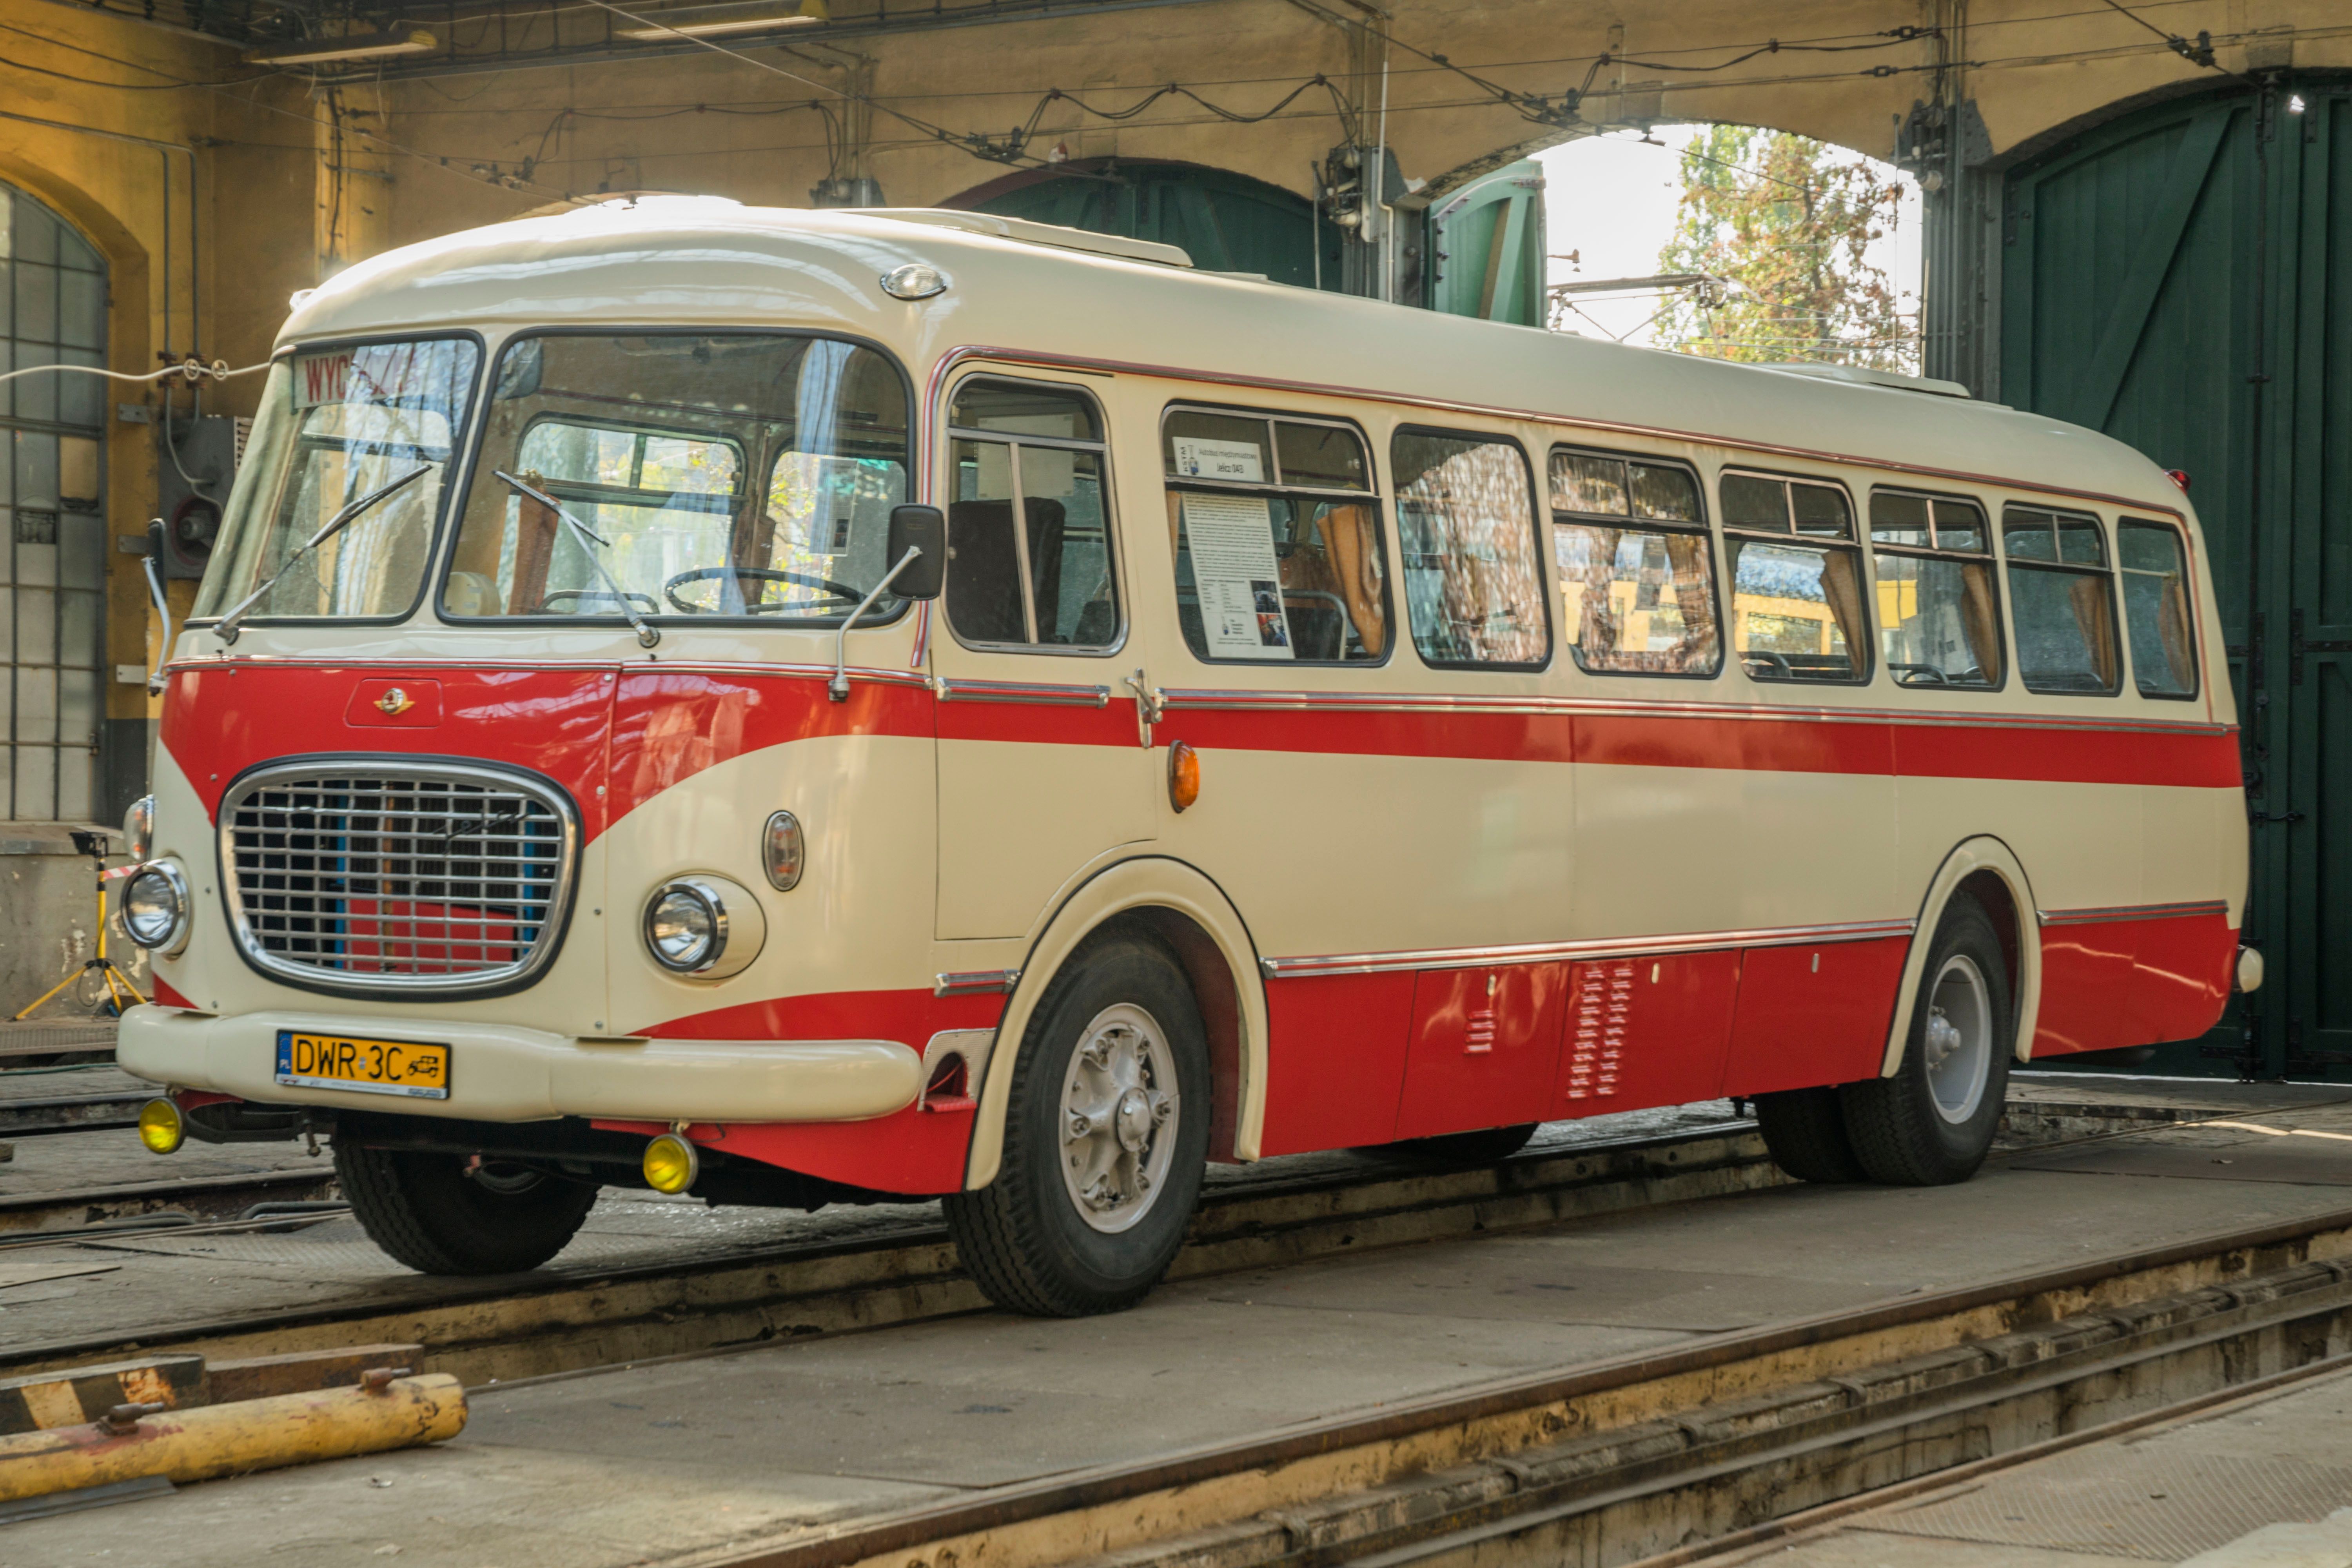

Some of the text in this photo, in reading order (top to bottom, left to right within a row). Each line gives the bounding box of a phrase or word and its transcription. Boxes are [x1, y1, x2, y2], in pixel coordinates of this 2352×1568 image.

[1198, 448, 1218, 457] Autobus
[279, 1059, 291, 1069] PL
[297, 1039, 403, 1081] DWR 3C
